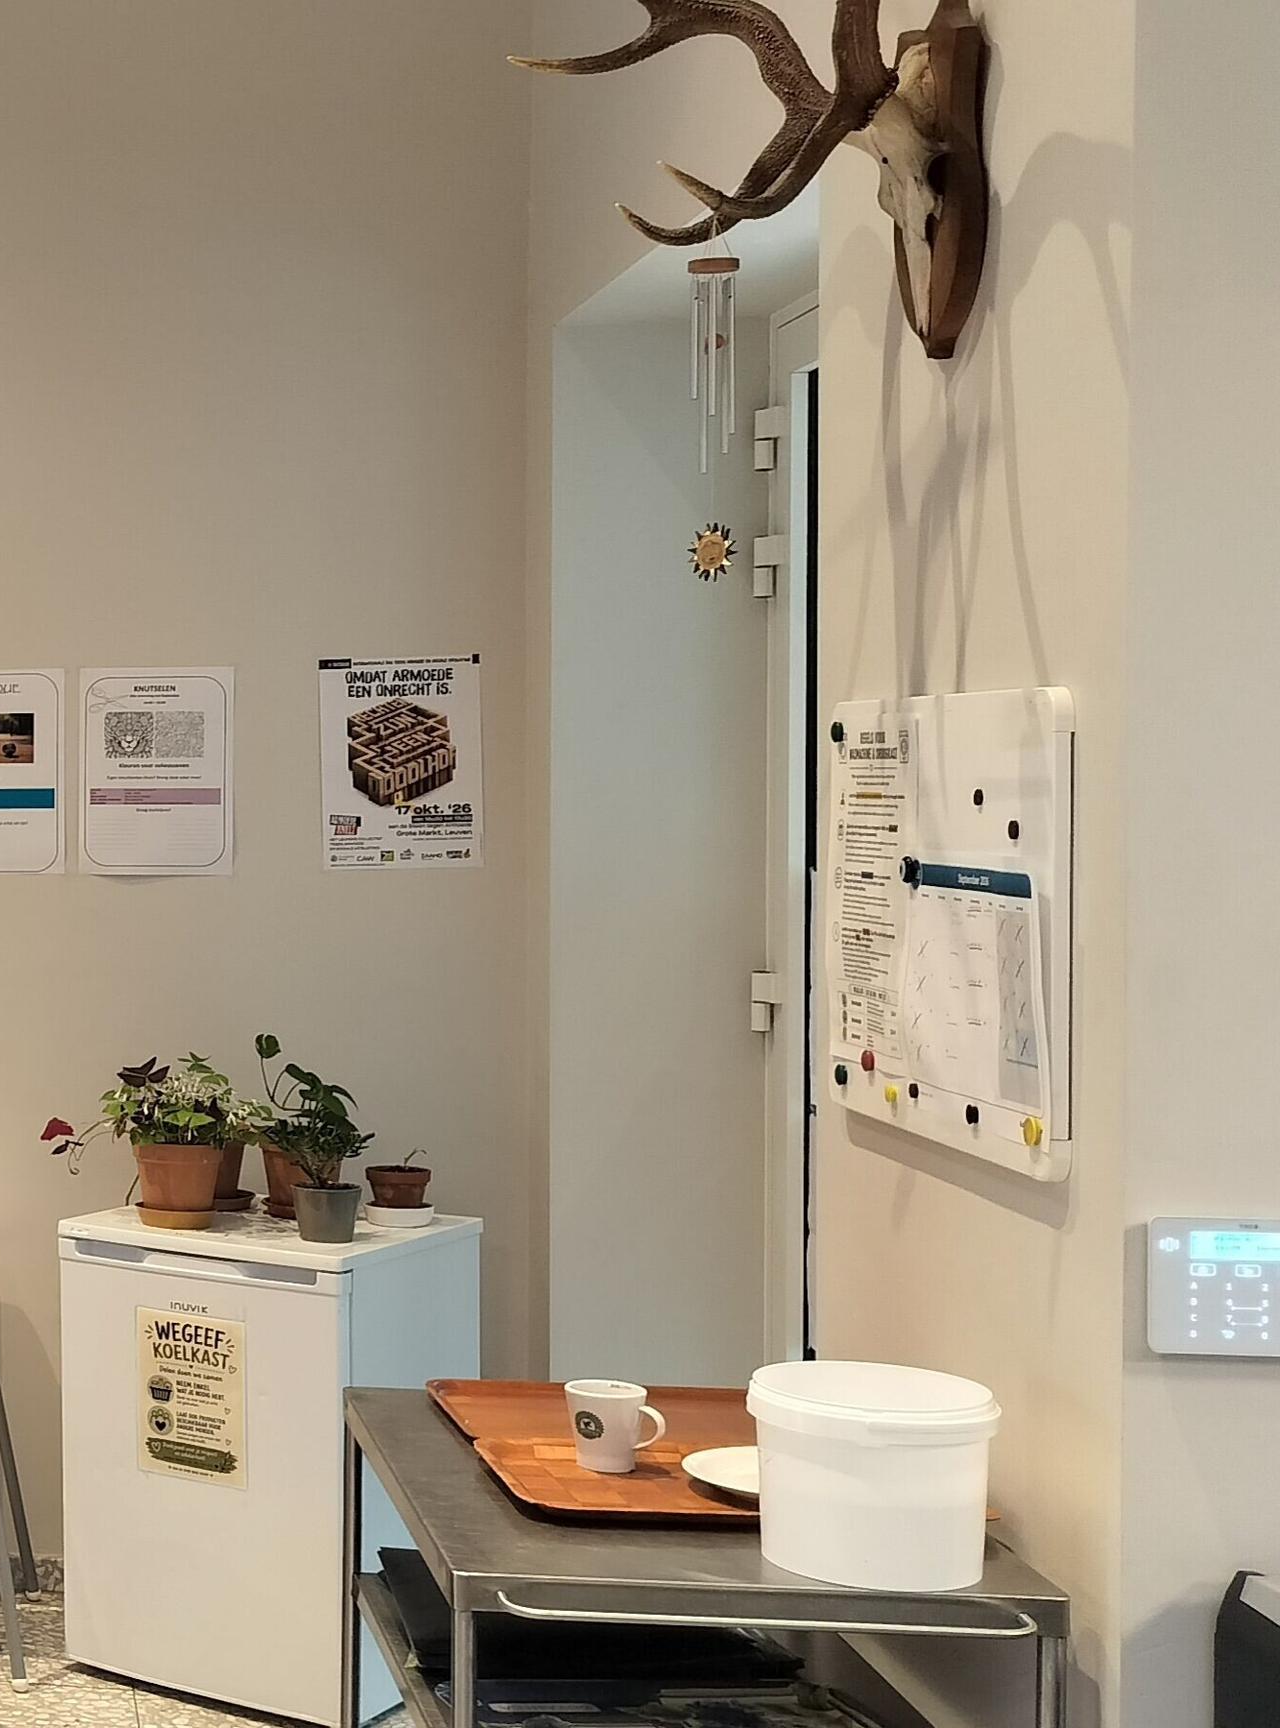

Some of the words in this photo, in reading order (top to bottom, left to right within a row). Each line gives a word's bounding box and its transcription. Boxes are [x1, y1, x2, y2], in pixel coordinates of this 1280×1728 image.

[345, 670, 388, 684] OMDAT
[392, 668, 454, 682] ARMOEDE
[348, 685, 372, 698] EEN
[376, 683, 432, 697] ONRECHT
[395, 805, 410, 815] 17
[414, 804, 444, 814] okt.
[1225, 1283, 1232, 1291] 1
[1261, 1283, 1269, 1292] 2
[154, 1320, 227, 1350] WEGEEF
[152, 1342, 230, 1369] KOELKAST
